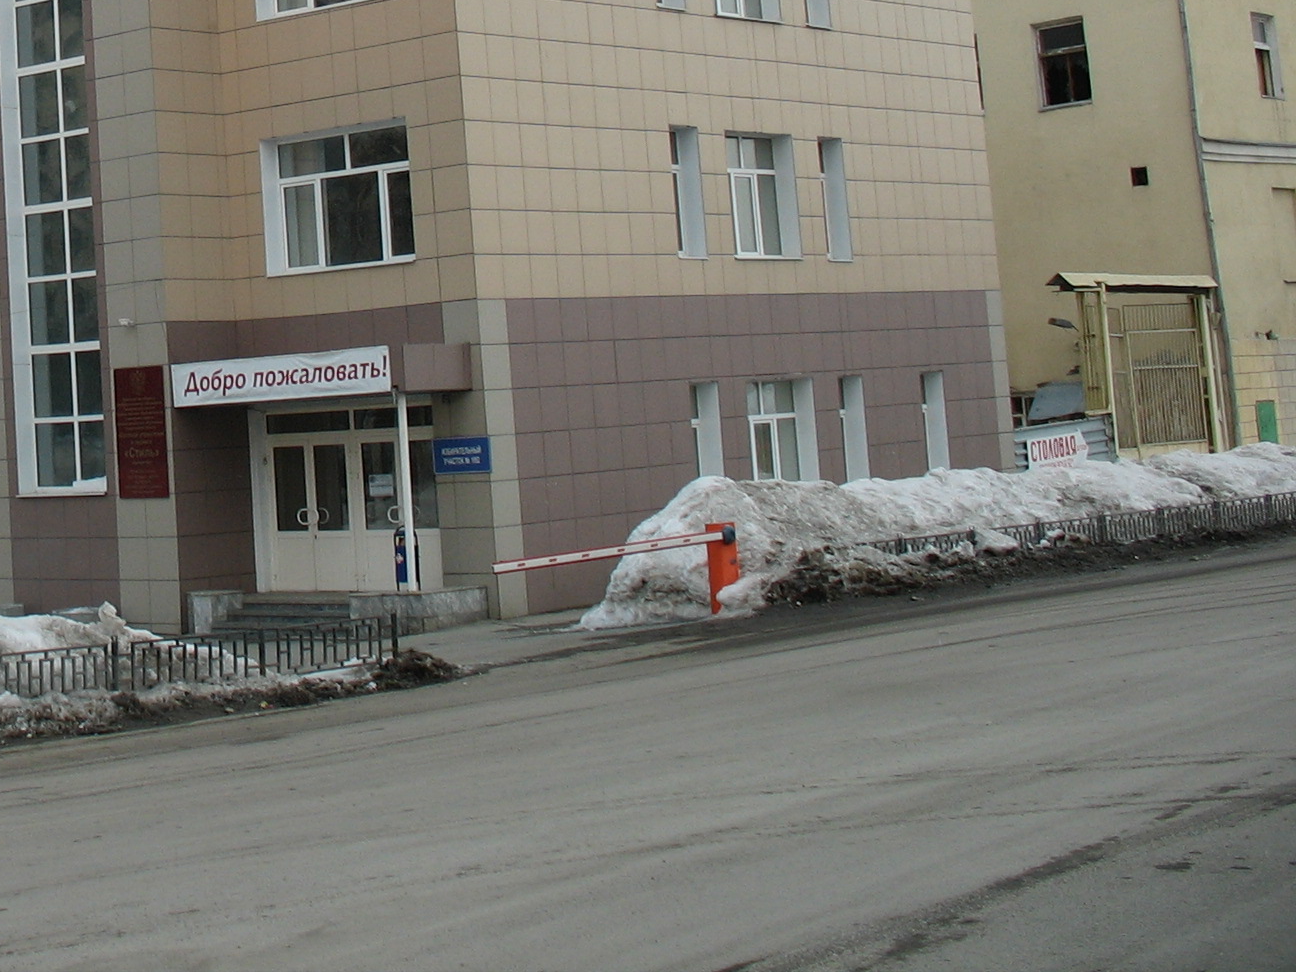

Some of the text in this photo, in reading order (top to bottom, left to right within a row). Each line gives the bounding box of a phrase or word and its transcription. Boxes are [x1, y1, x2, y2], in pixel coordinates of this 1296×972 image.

[184, 354, 388, 397] Добро пожаловать!
[1030, 435, 1078, 463] СТОЛОВАЯ
